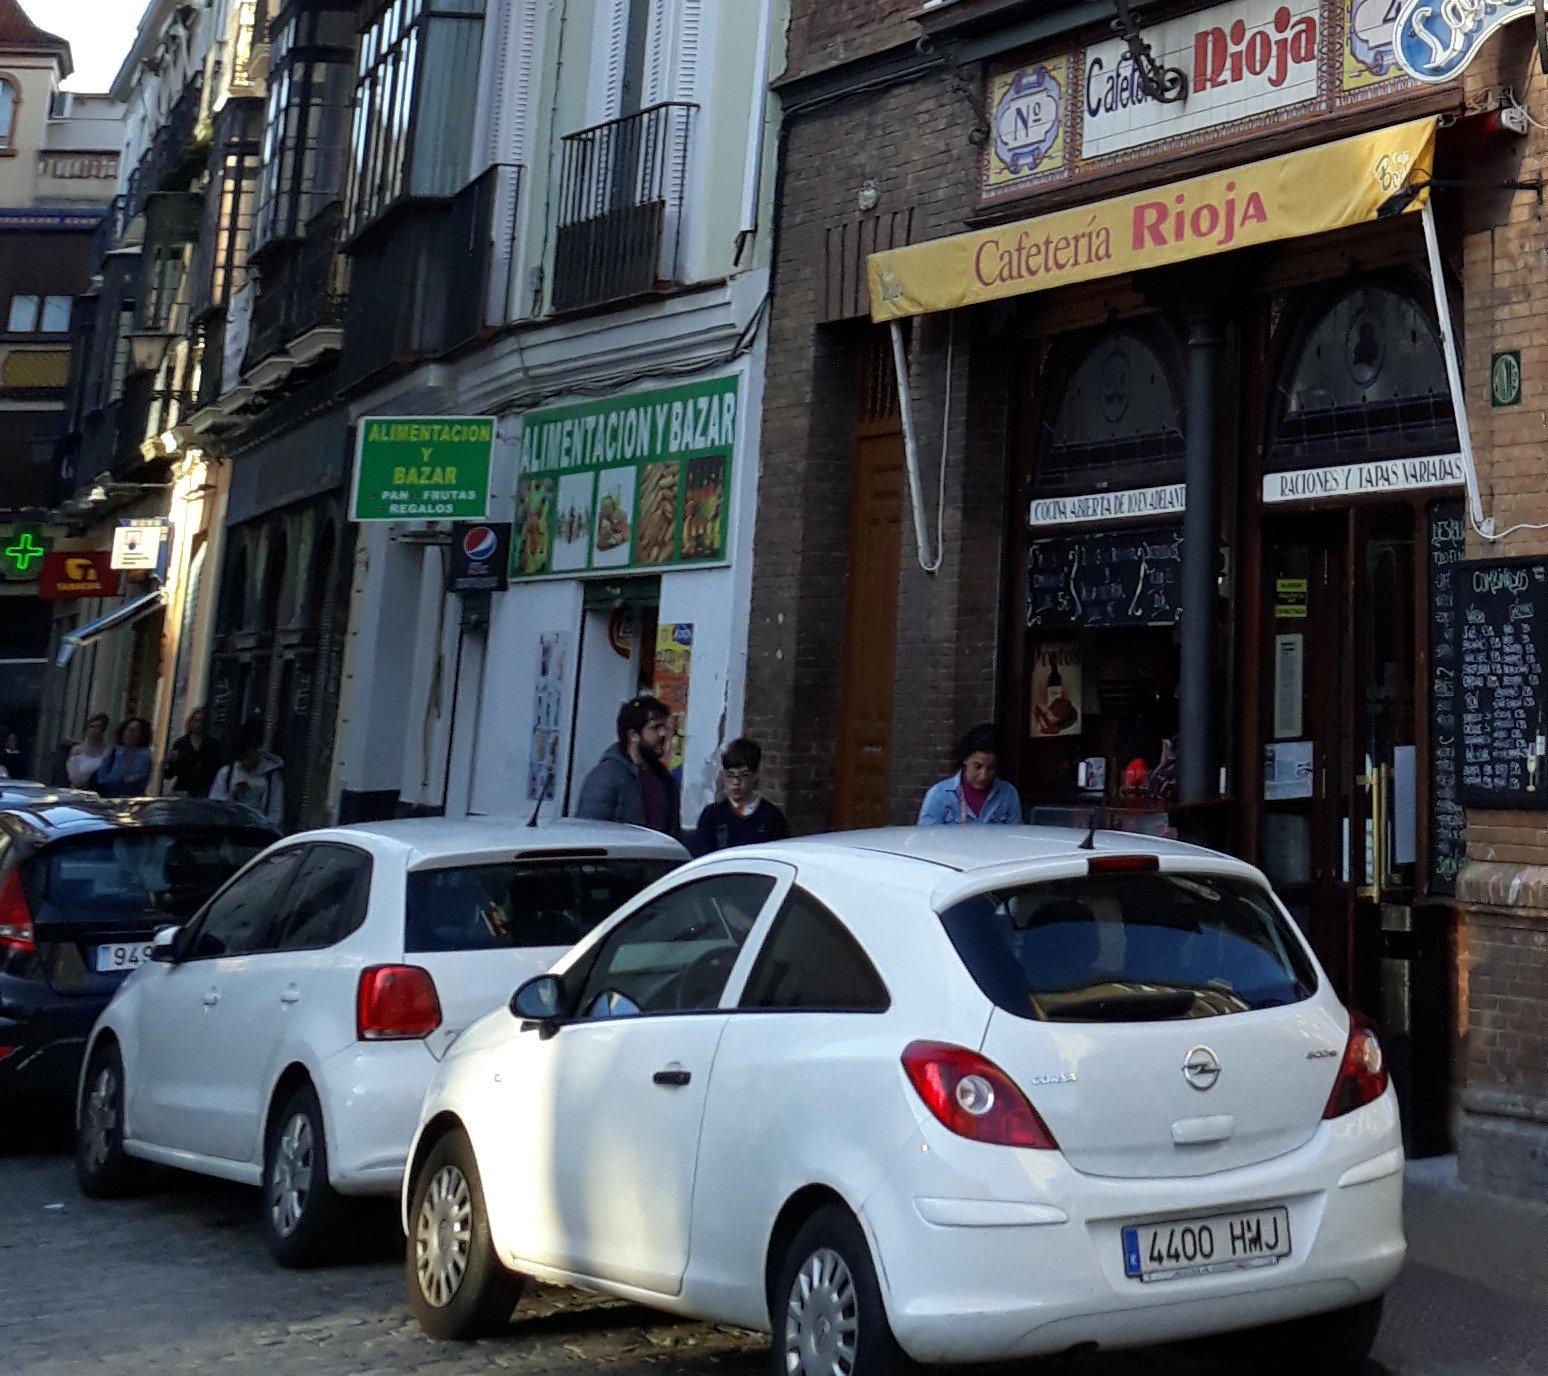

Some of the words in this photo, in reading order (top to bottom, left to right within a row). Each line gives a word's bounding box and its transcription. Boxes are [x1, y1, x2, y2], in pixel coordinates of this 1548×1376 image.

[1192, 6, 1318, 94] Rioja
[973, 214, 1114, 288] Cafetería
[368, 423, 492, 443] ALIMENTACION
[520, 404, 650, 472] ALIMENTACION
[653, 403, 669, 454] Y
[668, 392, 737, 452] BAZAR
[421, 447, 434, 462] Y
[392, 466, 458, 486] BAZAR
[1280, 469, 1340, 497] RACIONES
[1342, 467, 1354, 491] Y
[1358, 462, 1400, 489] TAPAS
[1402, 456, 1463, 484] VARIADAS
[381, 490, 409, 502] PAN
[422, 489, 477, 502] FRUTAS
[388, 503, 455, 515] REGALOS
[1148, 1224, 1214, 1266] 4400
[1229, 1215, 1280, 1254] HMJ
